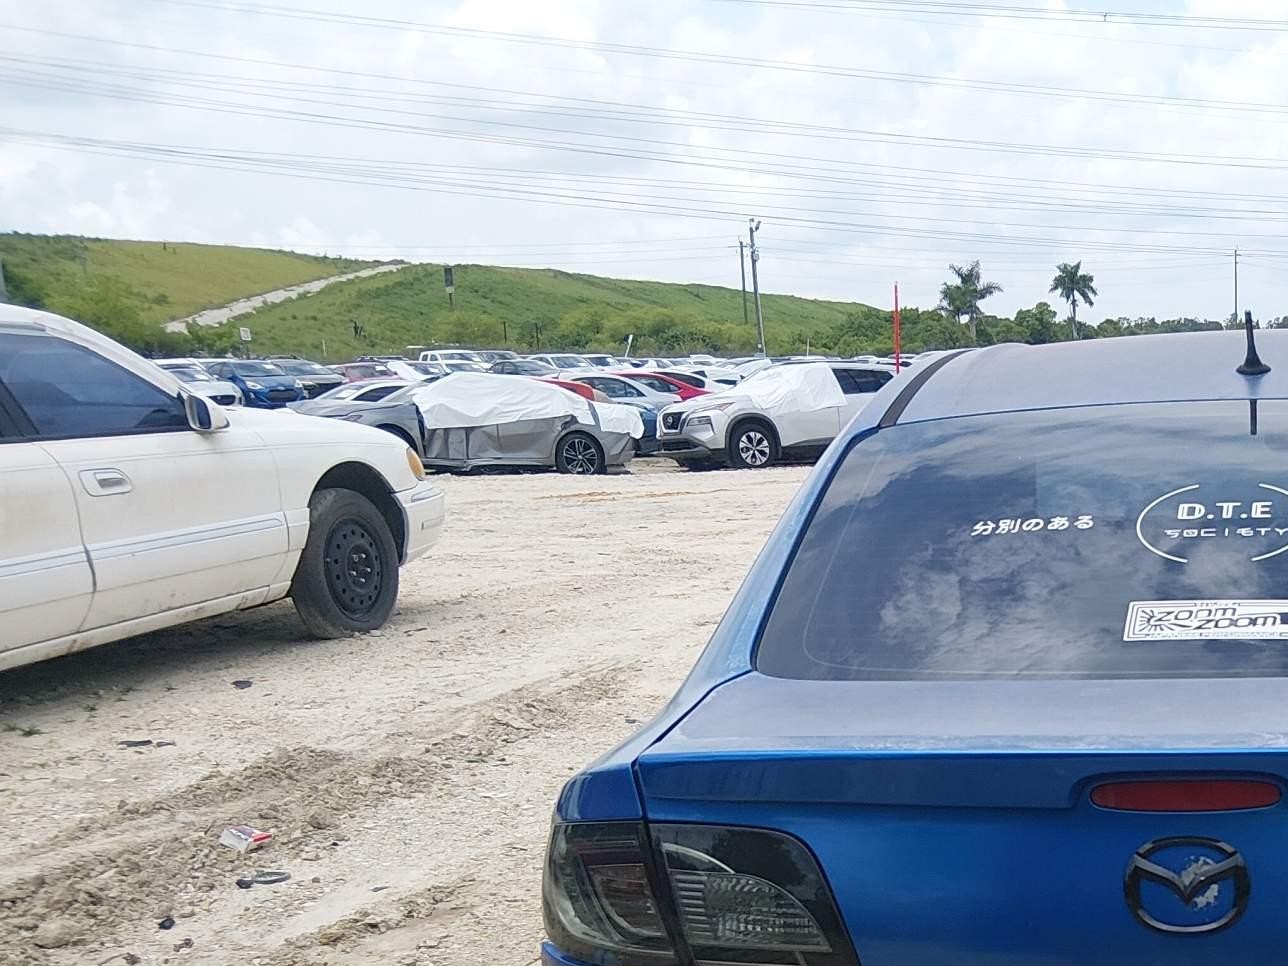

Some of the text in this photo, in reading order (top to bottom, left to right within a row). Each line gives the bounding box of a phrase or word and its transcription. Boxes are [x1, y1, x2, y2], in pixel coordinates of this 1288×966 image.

[1177, 502, 1273, 520] D.T.E
[970, 515, 1094, 536] 分別のある
